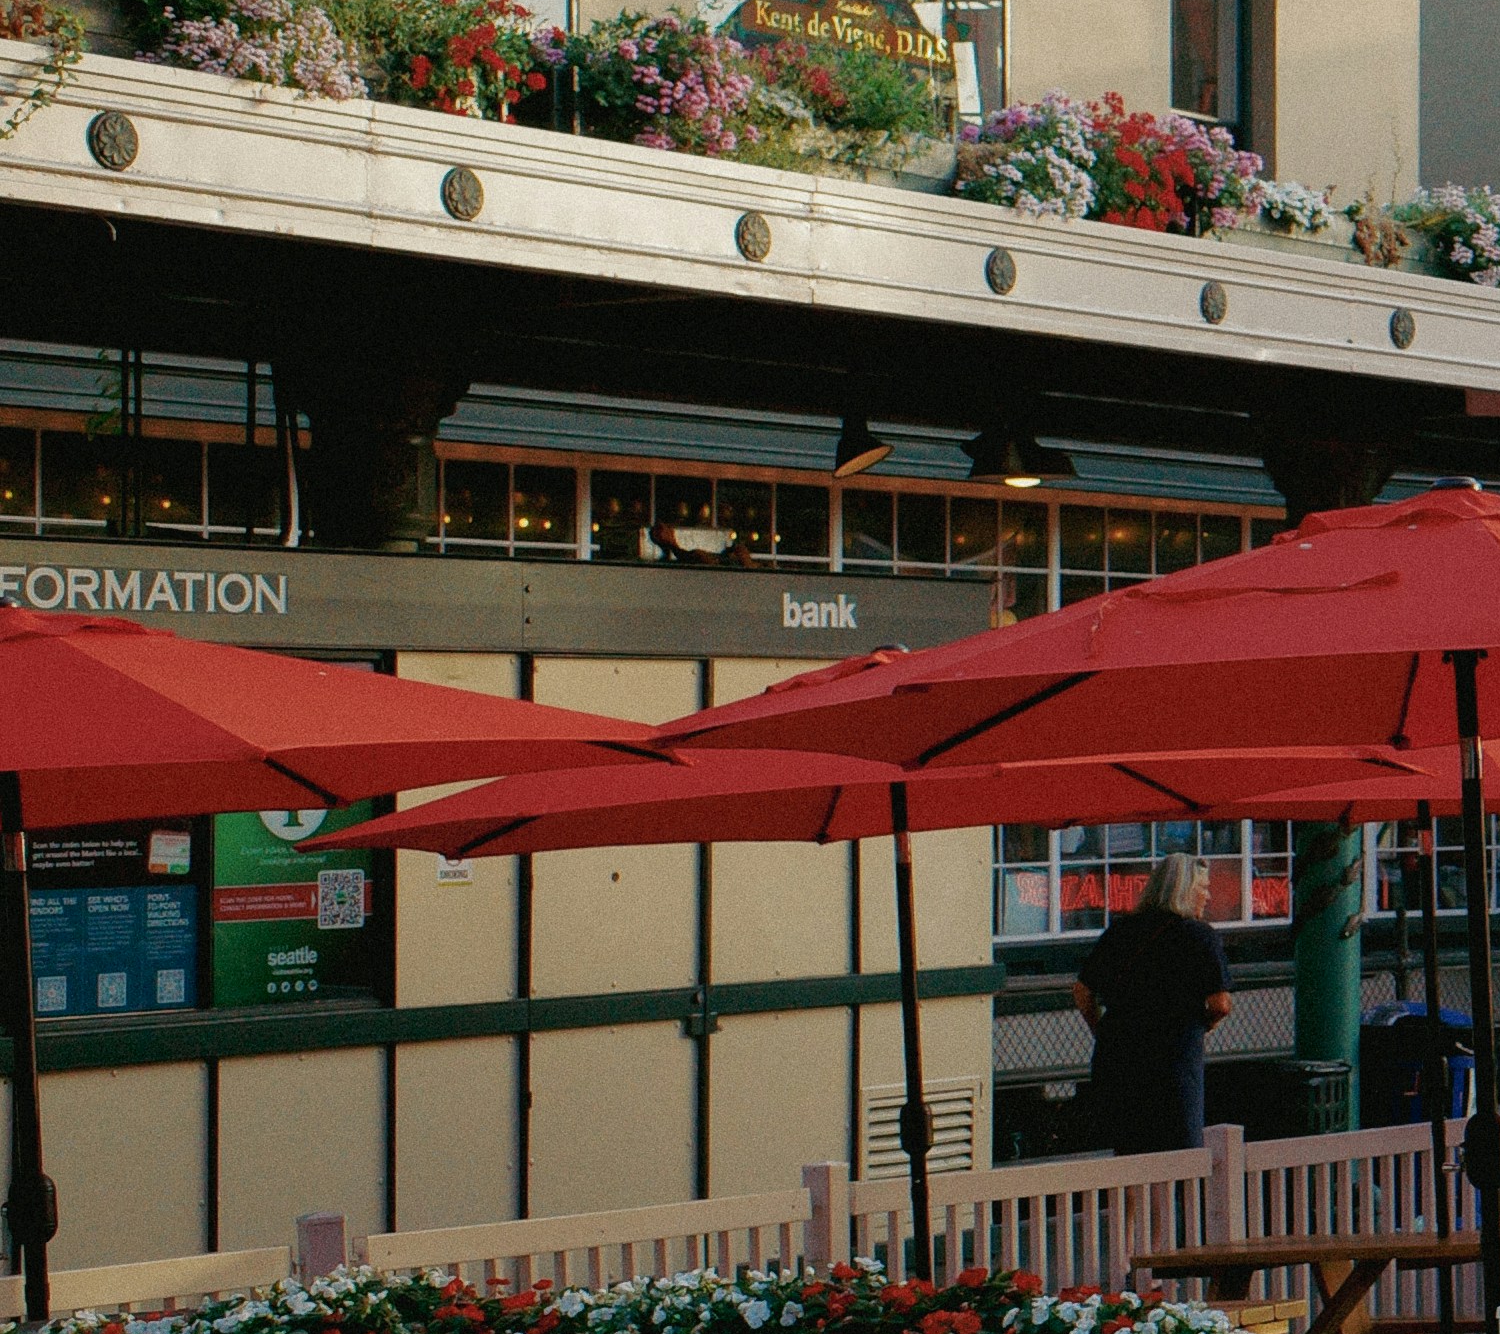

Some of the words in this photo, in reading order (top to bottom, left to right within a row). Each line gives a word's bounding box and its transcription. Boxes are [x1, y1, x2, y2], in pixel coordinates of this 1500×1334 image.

[754, 0, 802, 32] Kent
[807, 13, 832, 37] de
[782, 591, 858, 630] bank
[267, 945, 318, 967] seattle
